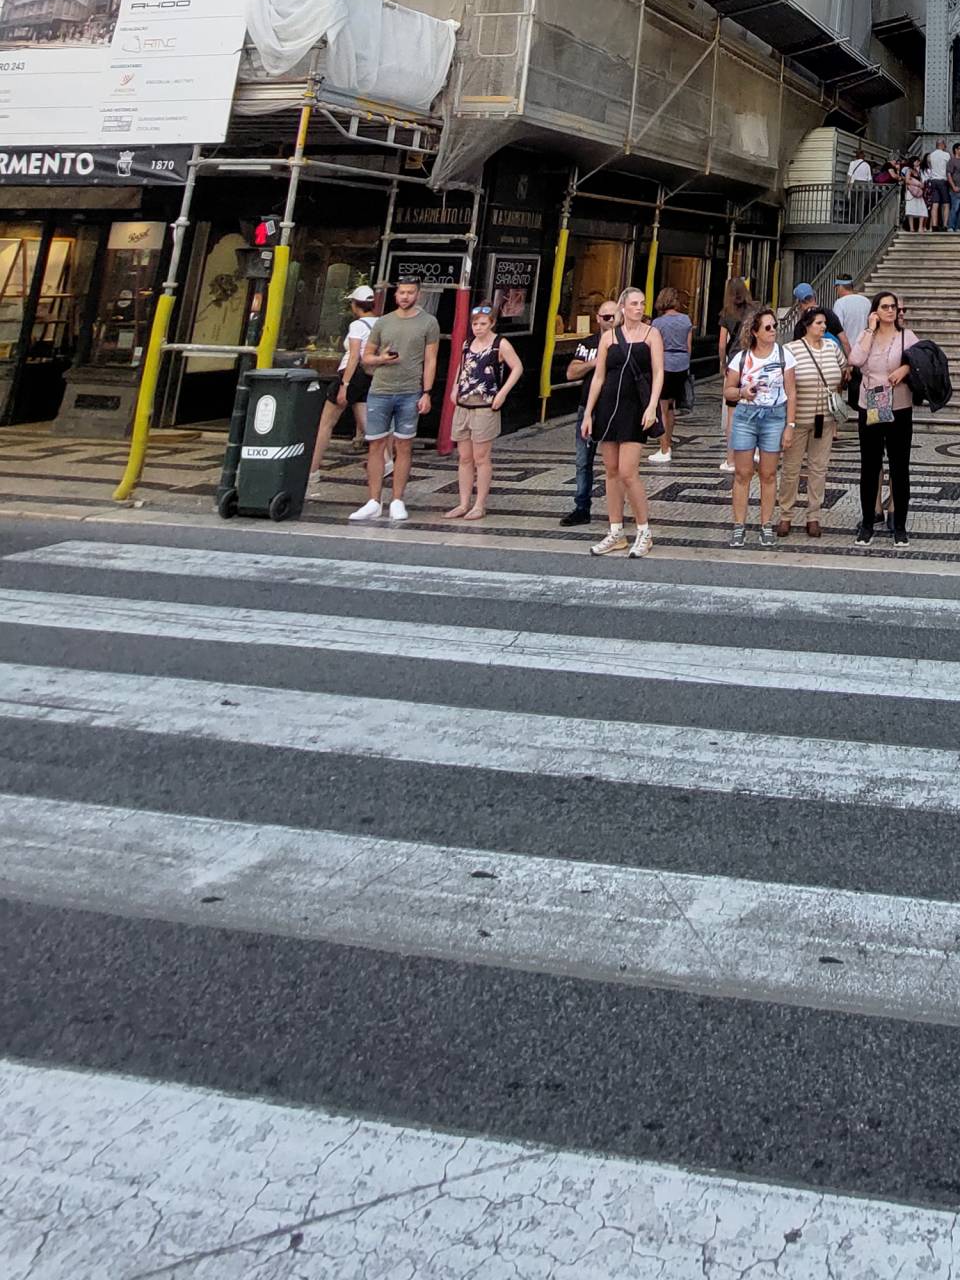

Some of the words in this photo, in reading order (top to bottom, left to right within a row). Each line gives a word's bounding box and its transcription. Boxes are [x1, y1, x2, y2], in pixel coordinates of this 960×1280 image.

[11, 62, 25, 71] 243
[151, 160, 175, 170] 1870
[398, 263, 441, 276] ESPAÇO
[497, 262, 525, 276] ESPAÇO
[496, 274, 531, 285] SARMENTO
[247, 449, 268, 457] LIXO
